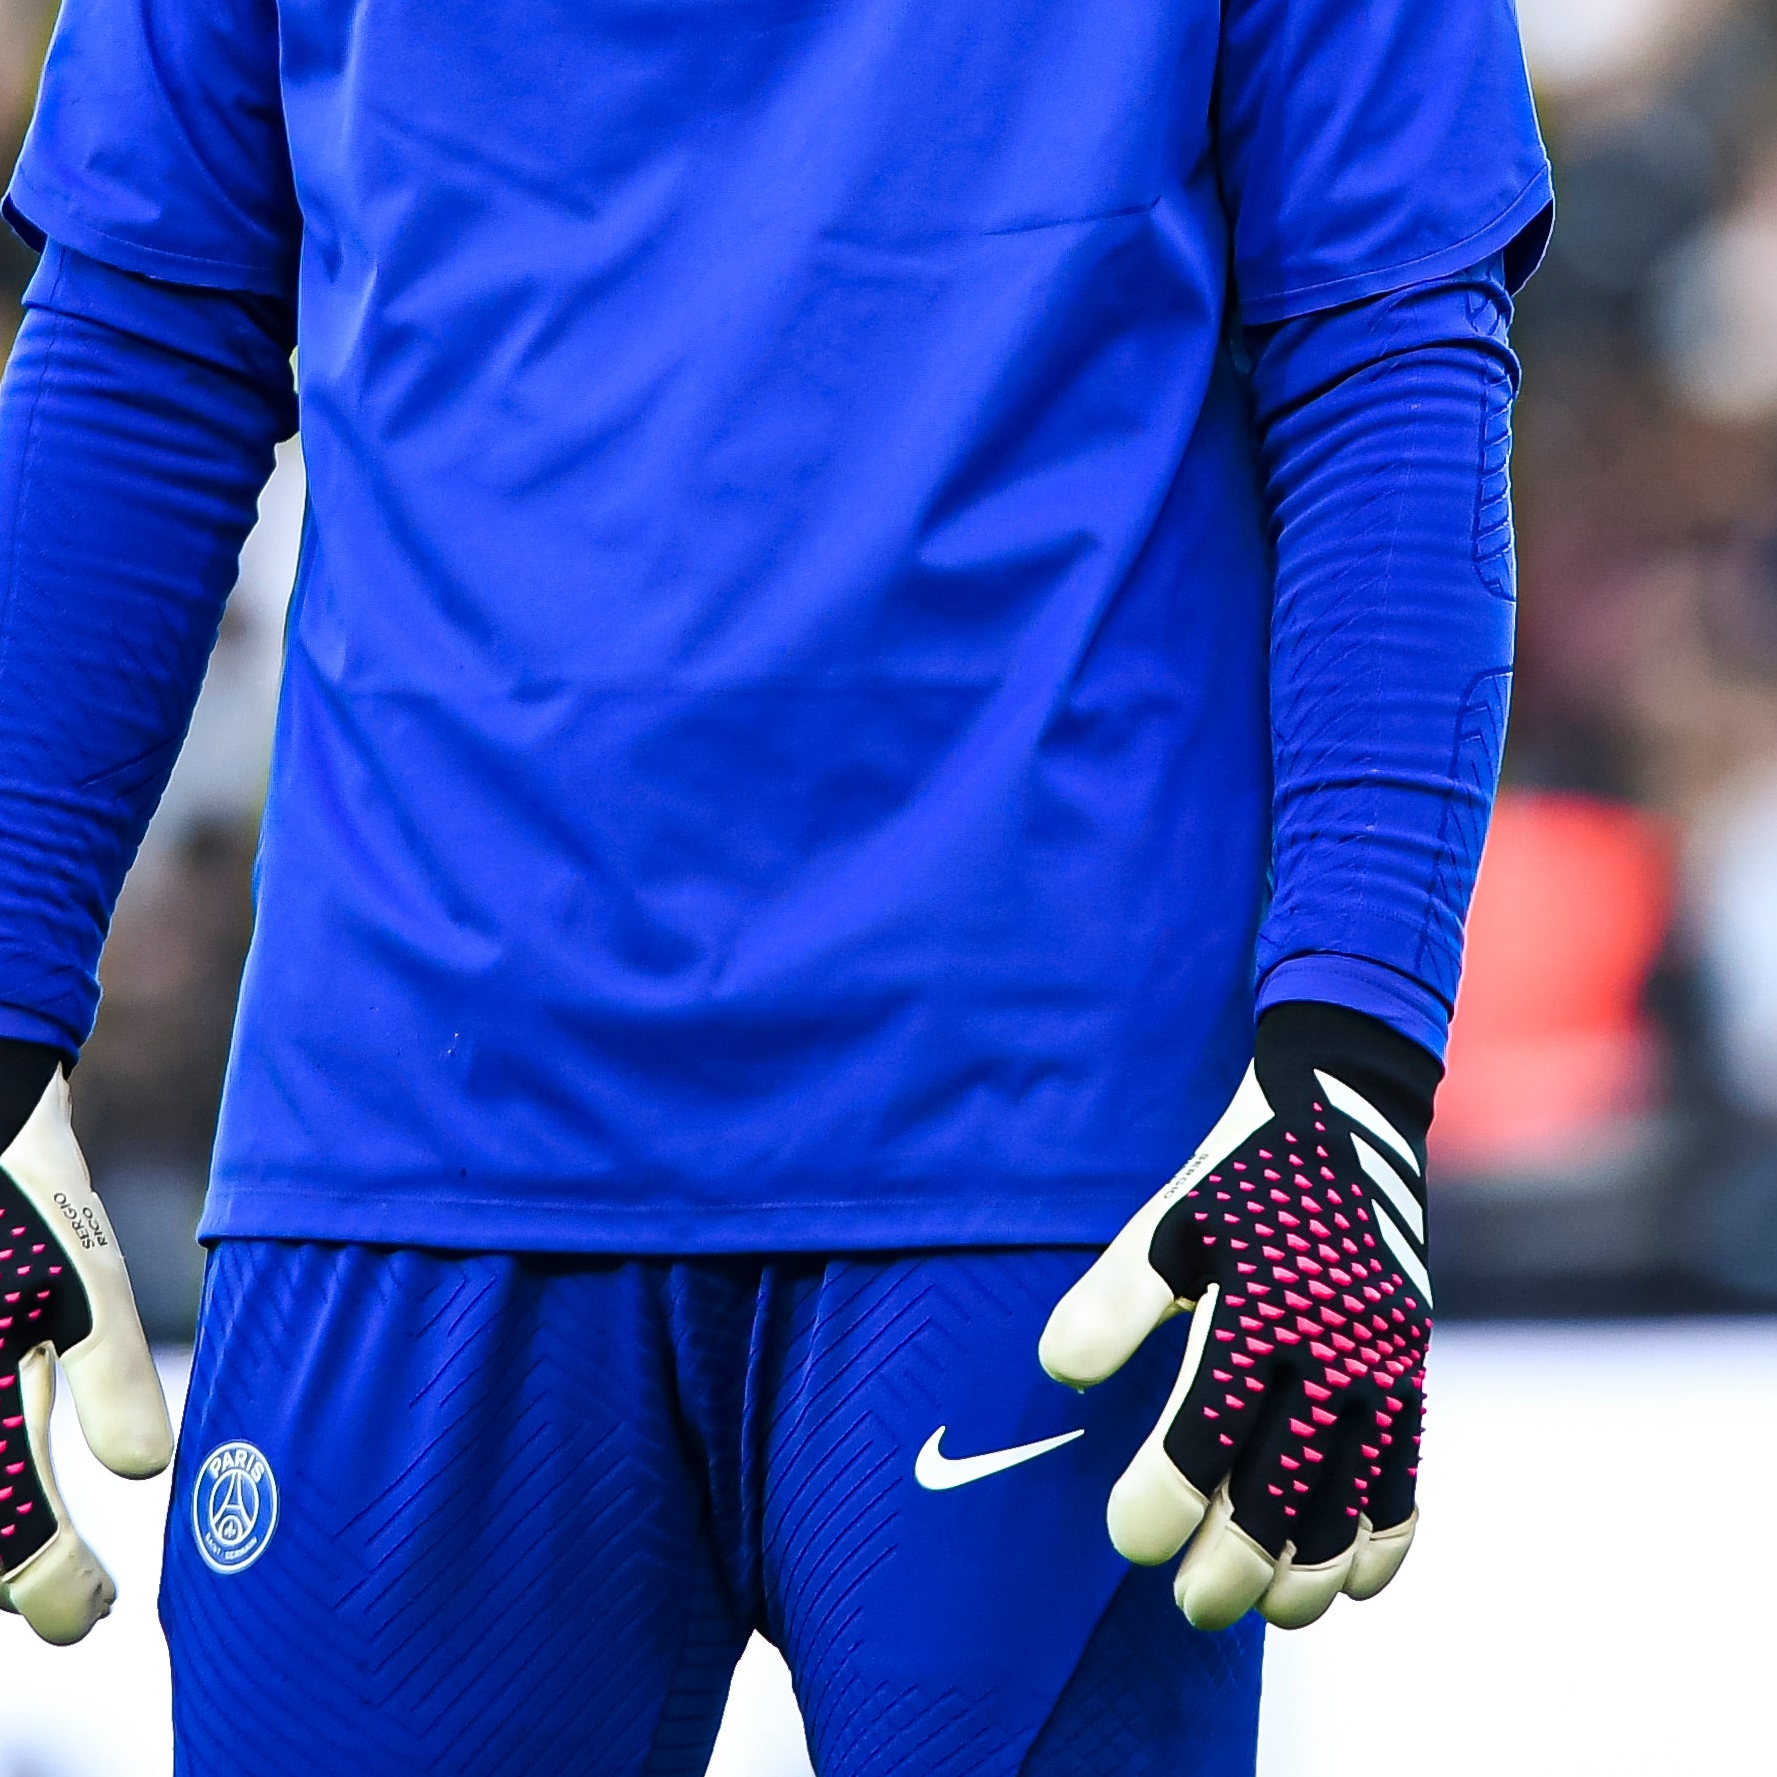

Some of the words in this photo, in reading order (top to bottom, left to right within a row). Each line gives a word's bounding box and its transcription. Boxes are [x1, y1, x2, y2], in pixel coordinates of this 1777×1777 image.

[53, 1192, 95, 1249] SERGIO
[82, 1207, 108, 1246] RICO
[208, 1449, 265, 1484] PARIS
